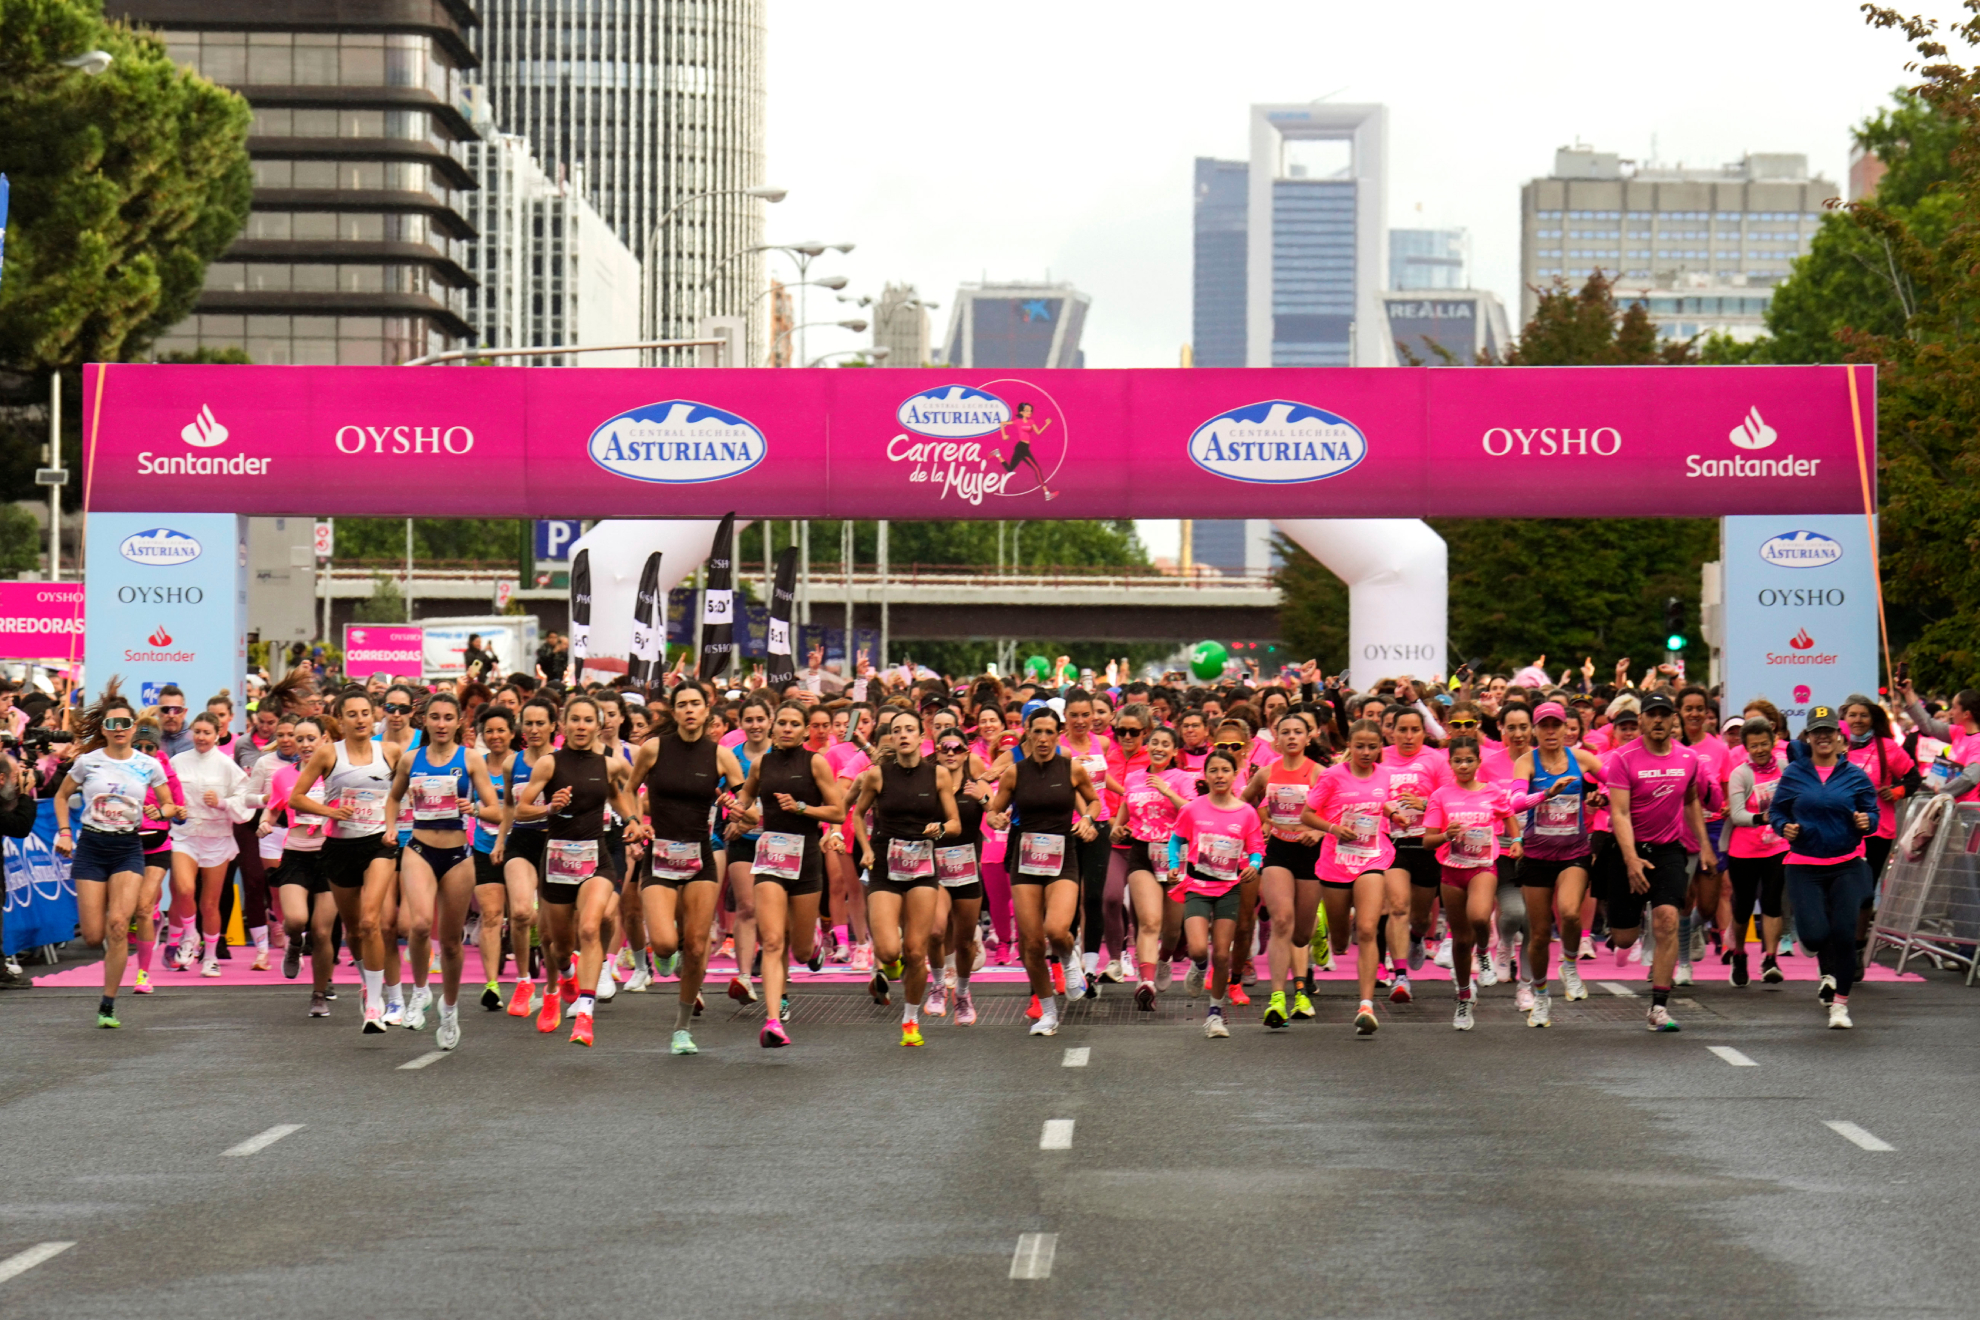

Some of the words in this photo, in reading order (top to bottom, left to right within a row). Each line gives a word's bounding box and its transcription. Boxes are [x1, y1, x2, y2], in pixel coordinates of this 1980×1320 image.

[1389, 302, 1472, 319] REALIA
[906, 404, 1001, 424] ASTURIANA
[334, 426, 475, 455] OYSHO
[629, 429, 685, 437] CENTRAL
[690, 429, 748, 437] LECHERA
[1229, 429, 1285, 437] CENTRAL
[1290, 429, 1348, 437] LECHERA
[1482, 426, 1622, 456] OYSHO
[602, 431, 753, 462] ASTURIANA
[886, 433, 982, 462] Carrera
[1202, 431, 1353, 462] ASTURIANA
[137, 452, 271, 475] Santander
[1685, 455, 1821, 478] Santander
[909, 463, 928, 483] de
[931, 463, 945, 483] la
[940, 459, 1017, 506] Mujer
[547, 521, 571, 556] P
[125, 541, 196, 557] ASTURIANA
[1766, 544, 1837, 558] ASTURIANA
[36, 591, 84, 603] OYSHO
[118, 585, 204, 604] OYSHO
[1758, 588, 1845, 607] OYSHO
[124, 649, 195, 662] Santander
[347, 649, 421, 662] CORREDORAS
[1364, 644, 1435, 660] OYSHO
[1766, 652, 1838, 665] Santander
[1815, 707, 1828, 718] B
[1638, 768, 1686, 778] SOLISS
[562, 860, 583, 869] 016
[1031, 852, 1049, 861] 016
